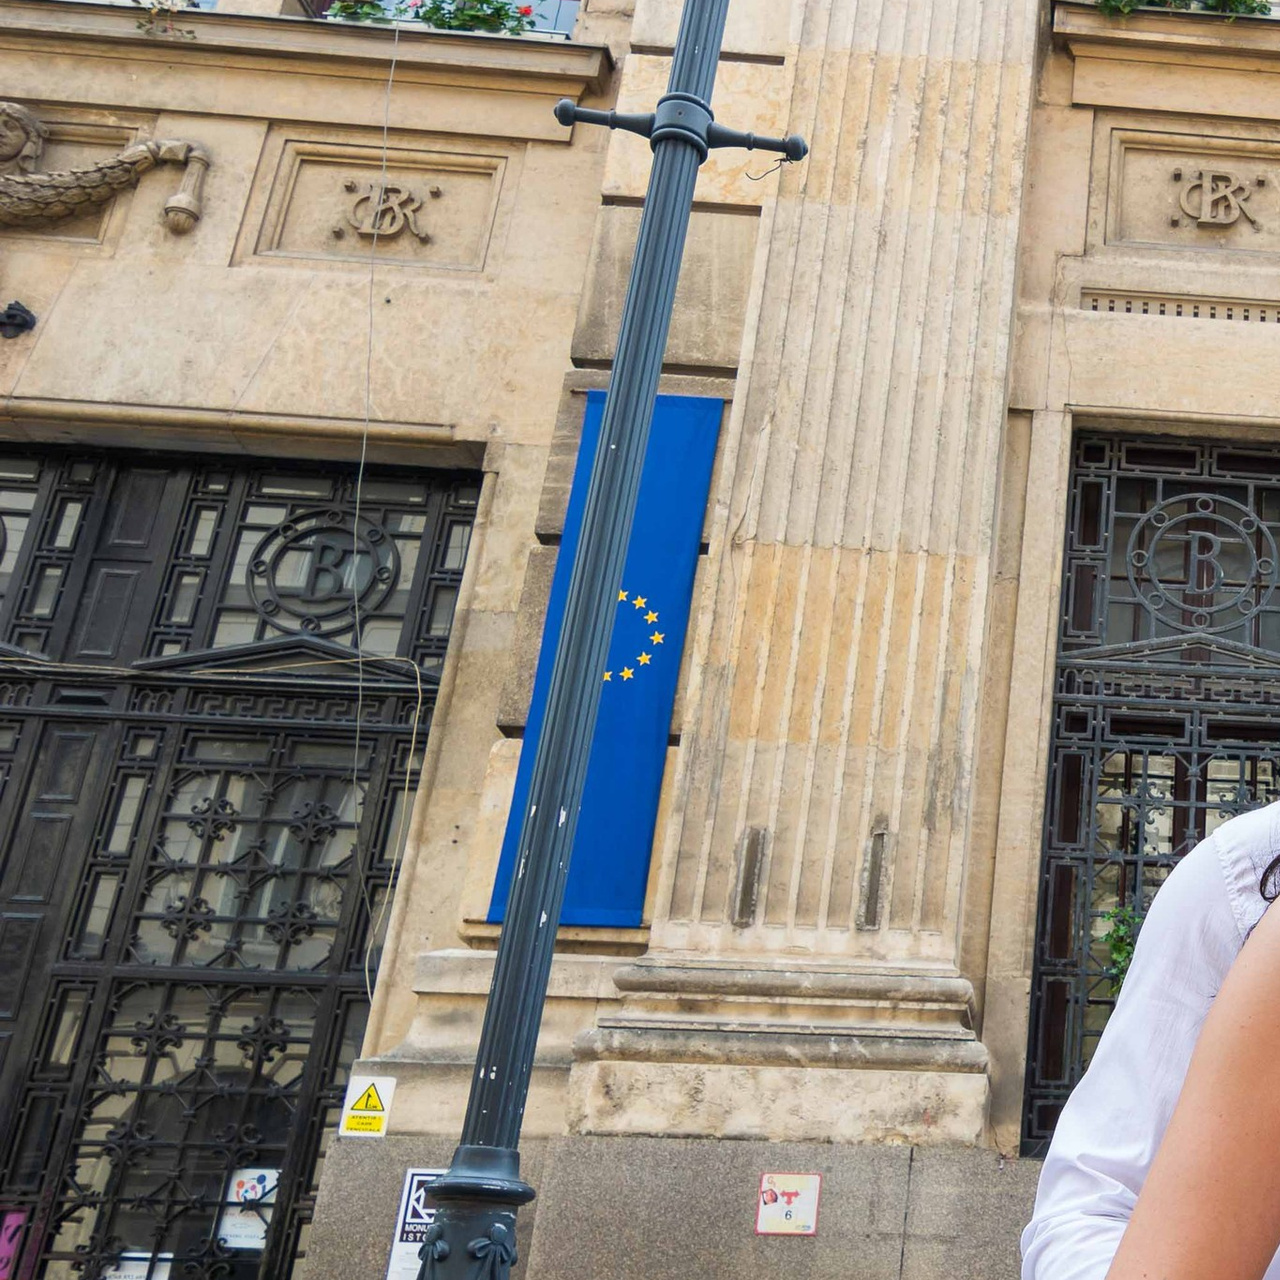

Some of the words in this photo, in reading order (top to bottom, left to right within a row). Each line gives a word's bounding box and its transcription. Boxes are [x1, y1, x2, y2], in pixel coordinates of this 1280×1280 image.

[300, 539, 344, 602] B
[1185, 530, 1225, 594] B
[405, 1224, 429, 1232] MONU
[785, 1210, 792, 1221] 6
